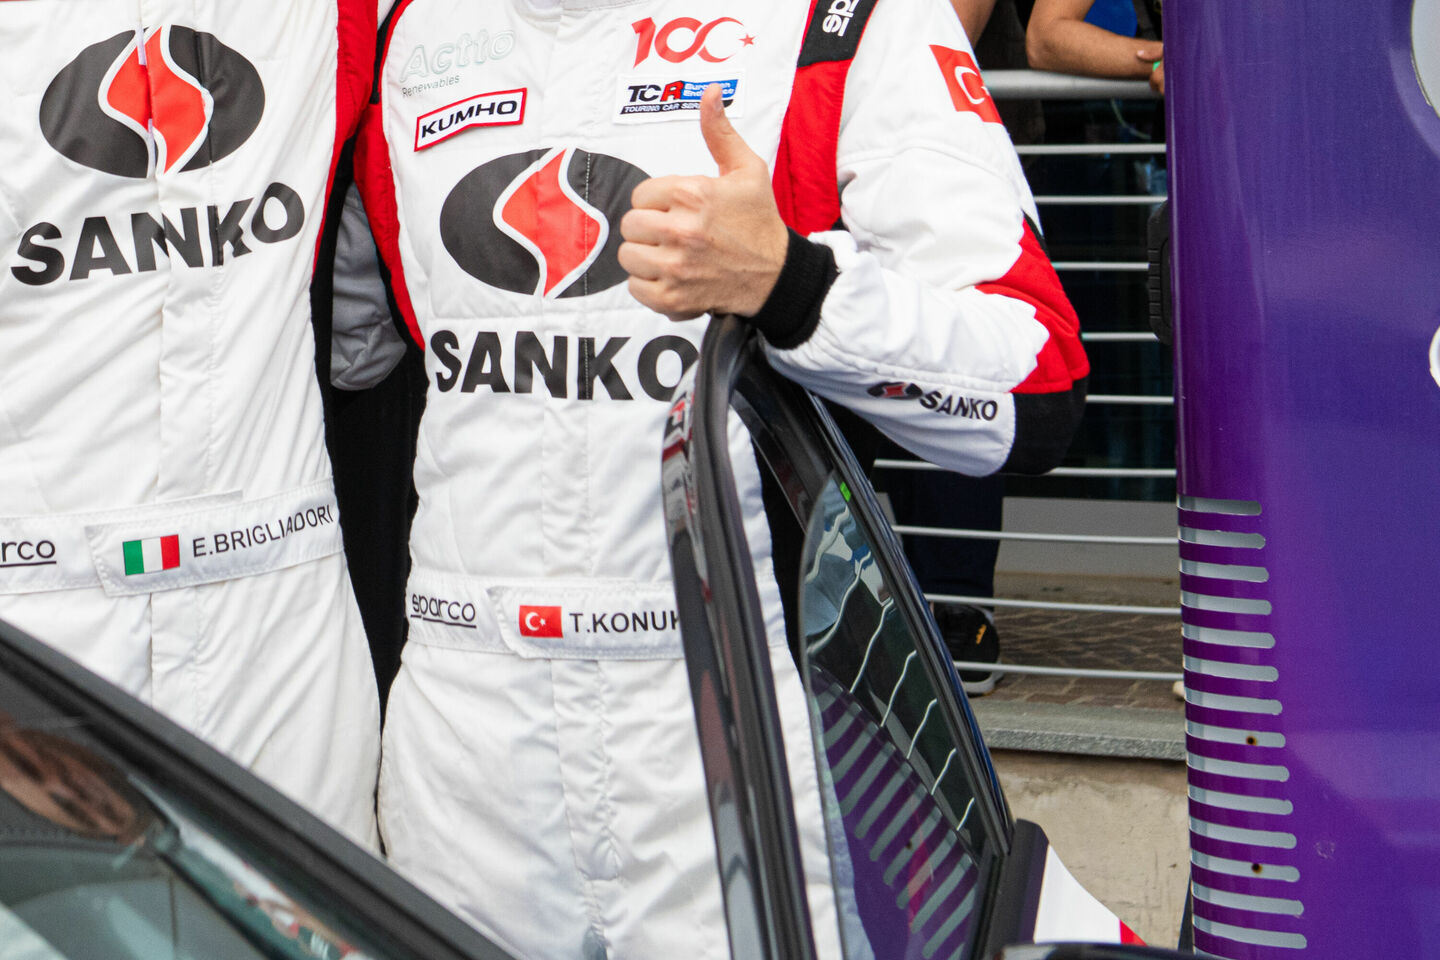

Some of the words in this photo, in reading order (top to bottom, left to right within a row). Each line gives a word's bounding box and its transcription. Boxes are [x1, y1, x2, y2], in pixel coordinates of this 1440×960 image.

[401, 74, 461, 98] Renewables
[628, 80, 685, 102] TCR
[421, 100, 518, 138] KUMHO
[624, 105, 660, 113] TOURING
[10, 181, 306, 286] SANKO
[429, 329, 700, 403] SANKO
[919, 390, 998, 421] SANKO
[192, 503, 334, 558] E.BRIGLIADORI
[410, 593, 477, 629] sparco
